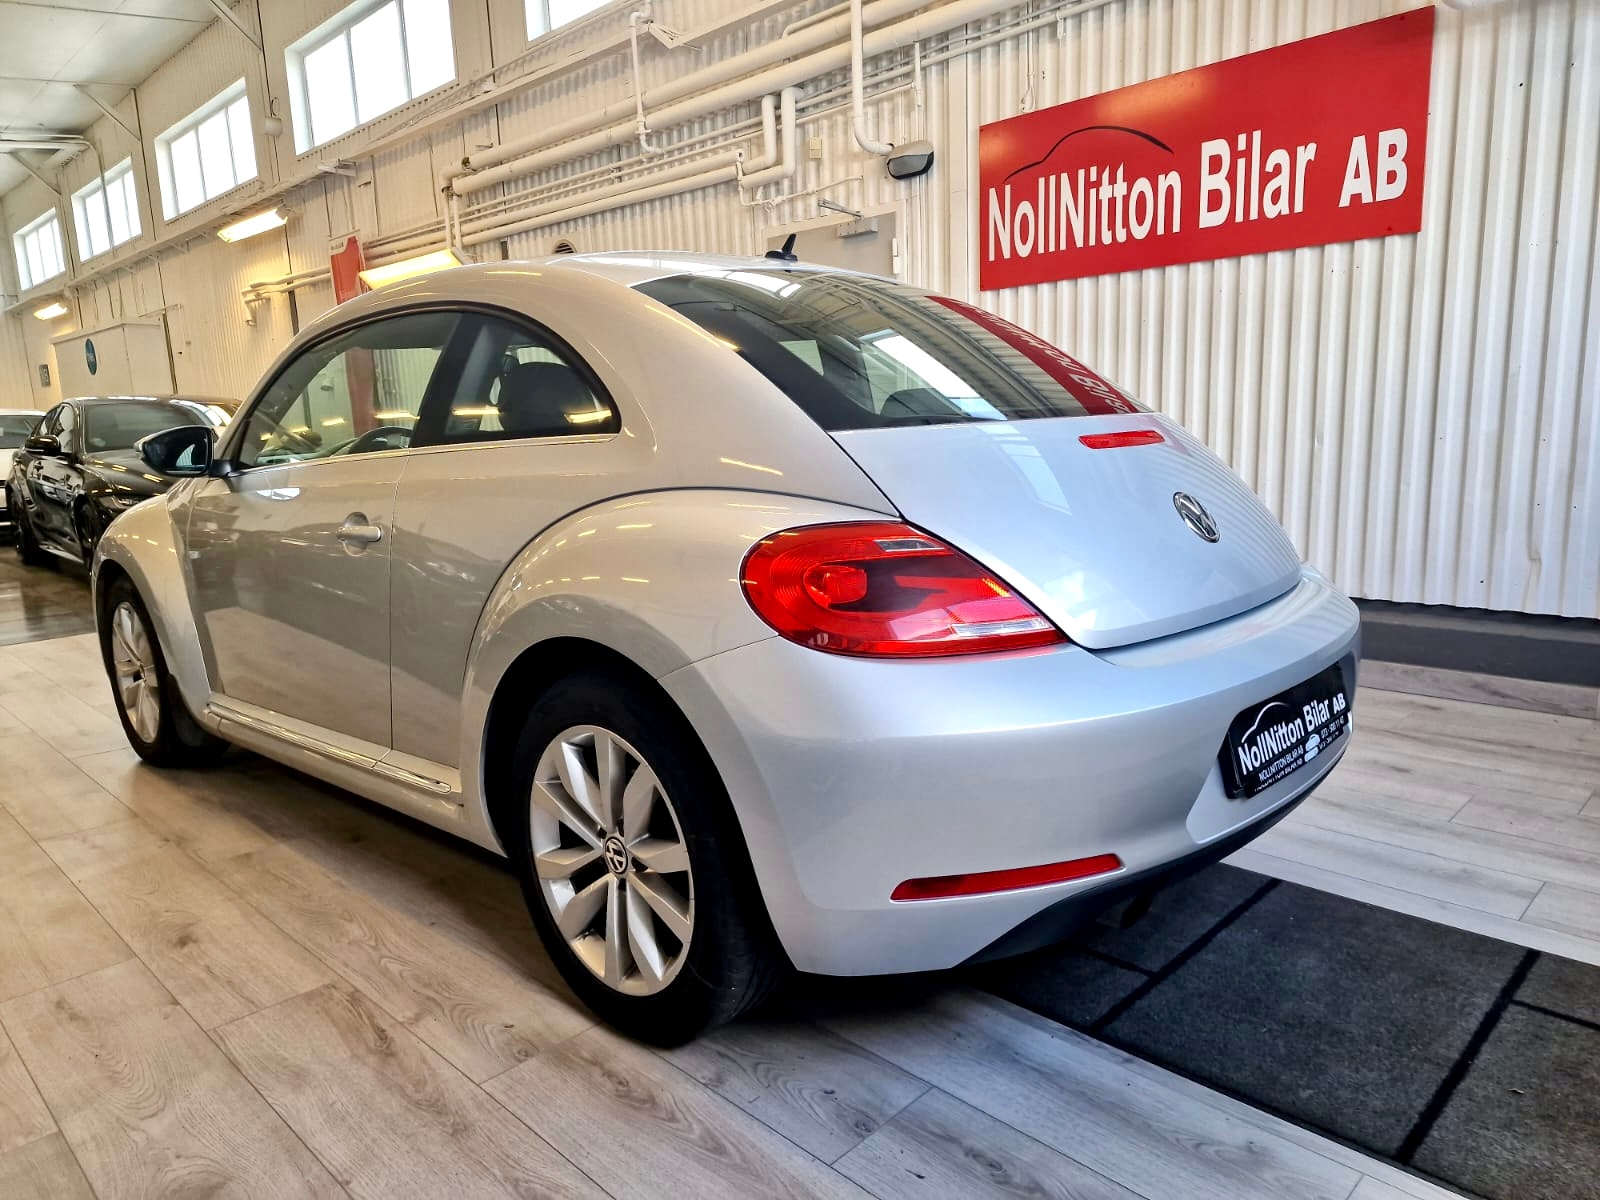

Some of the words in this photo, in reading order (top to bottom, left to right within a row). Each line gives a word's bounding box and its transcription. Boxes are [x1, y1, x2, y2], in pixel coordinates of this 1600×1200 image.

[988, 161, 1182, 262] NollNitton
[1199, 130, 1317, 229] Bilar
[1339, 128, 1408, 208] AB
[1238, 719, 1304, 775] NollNitton
[1303, 700, 1330, 732] Bilar
[1332, 693, 1346, 714] AB
